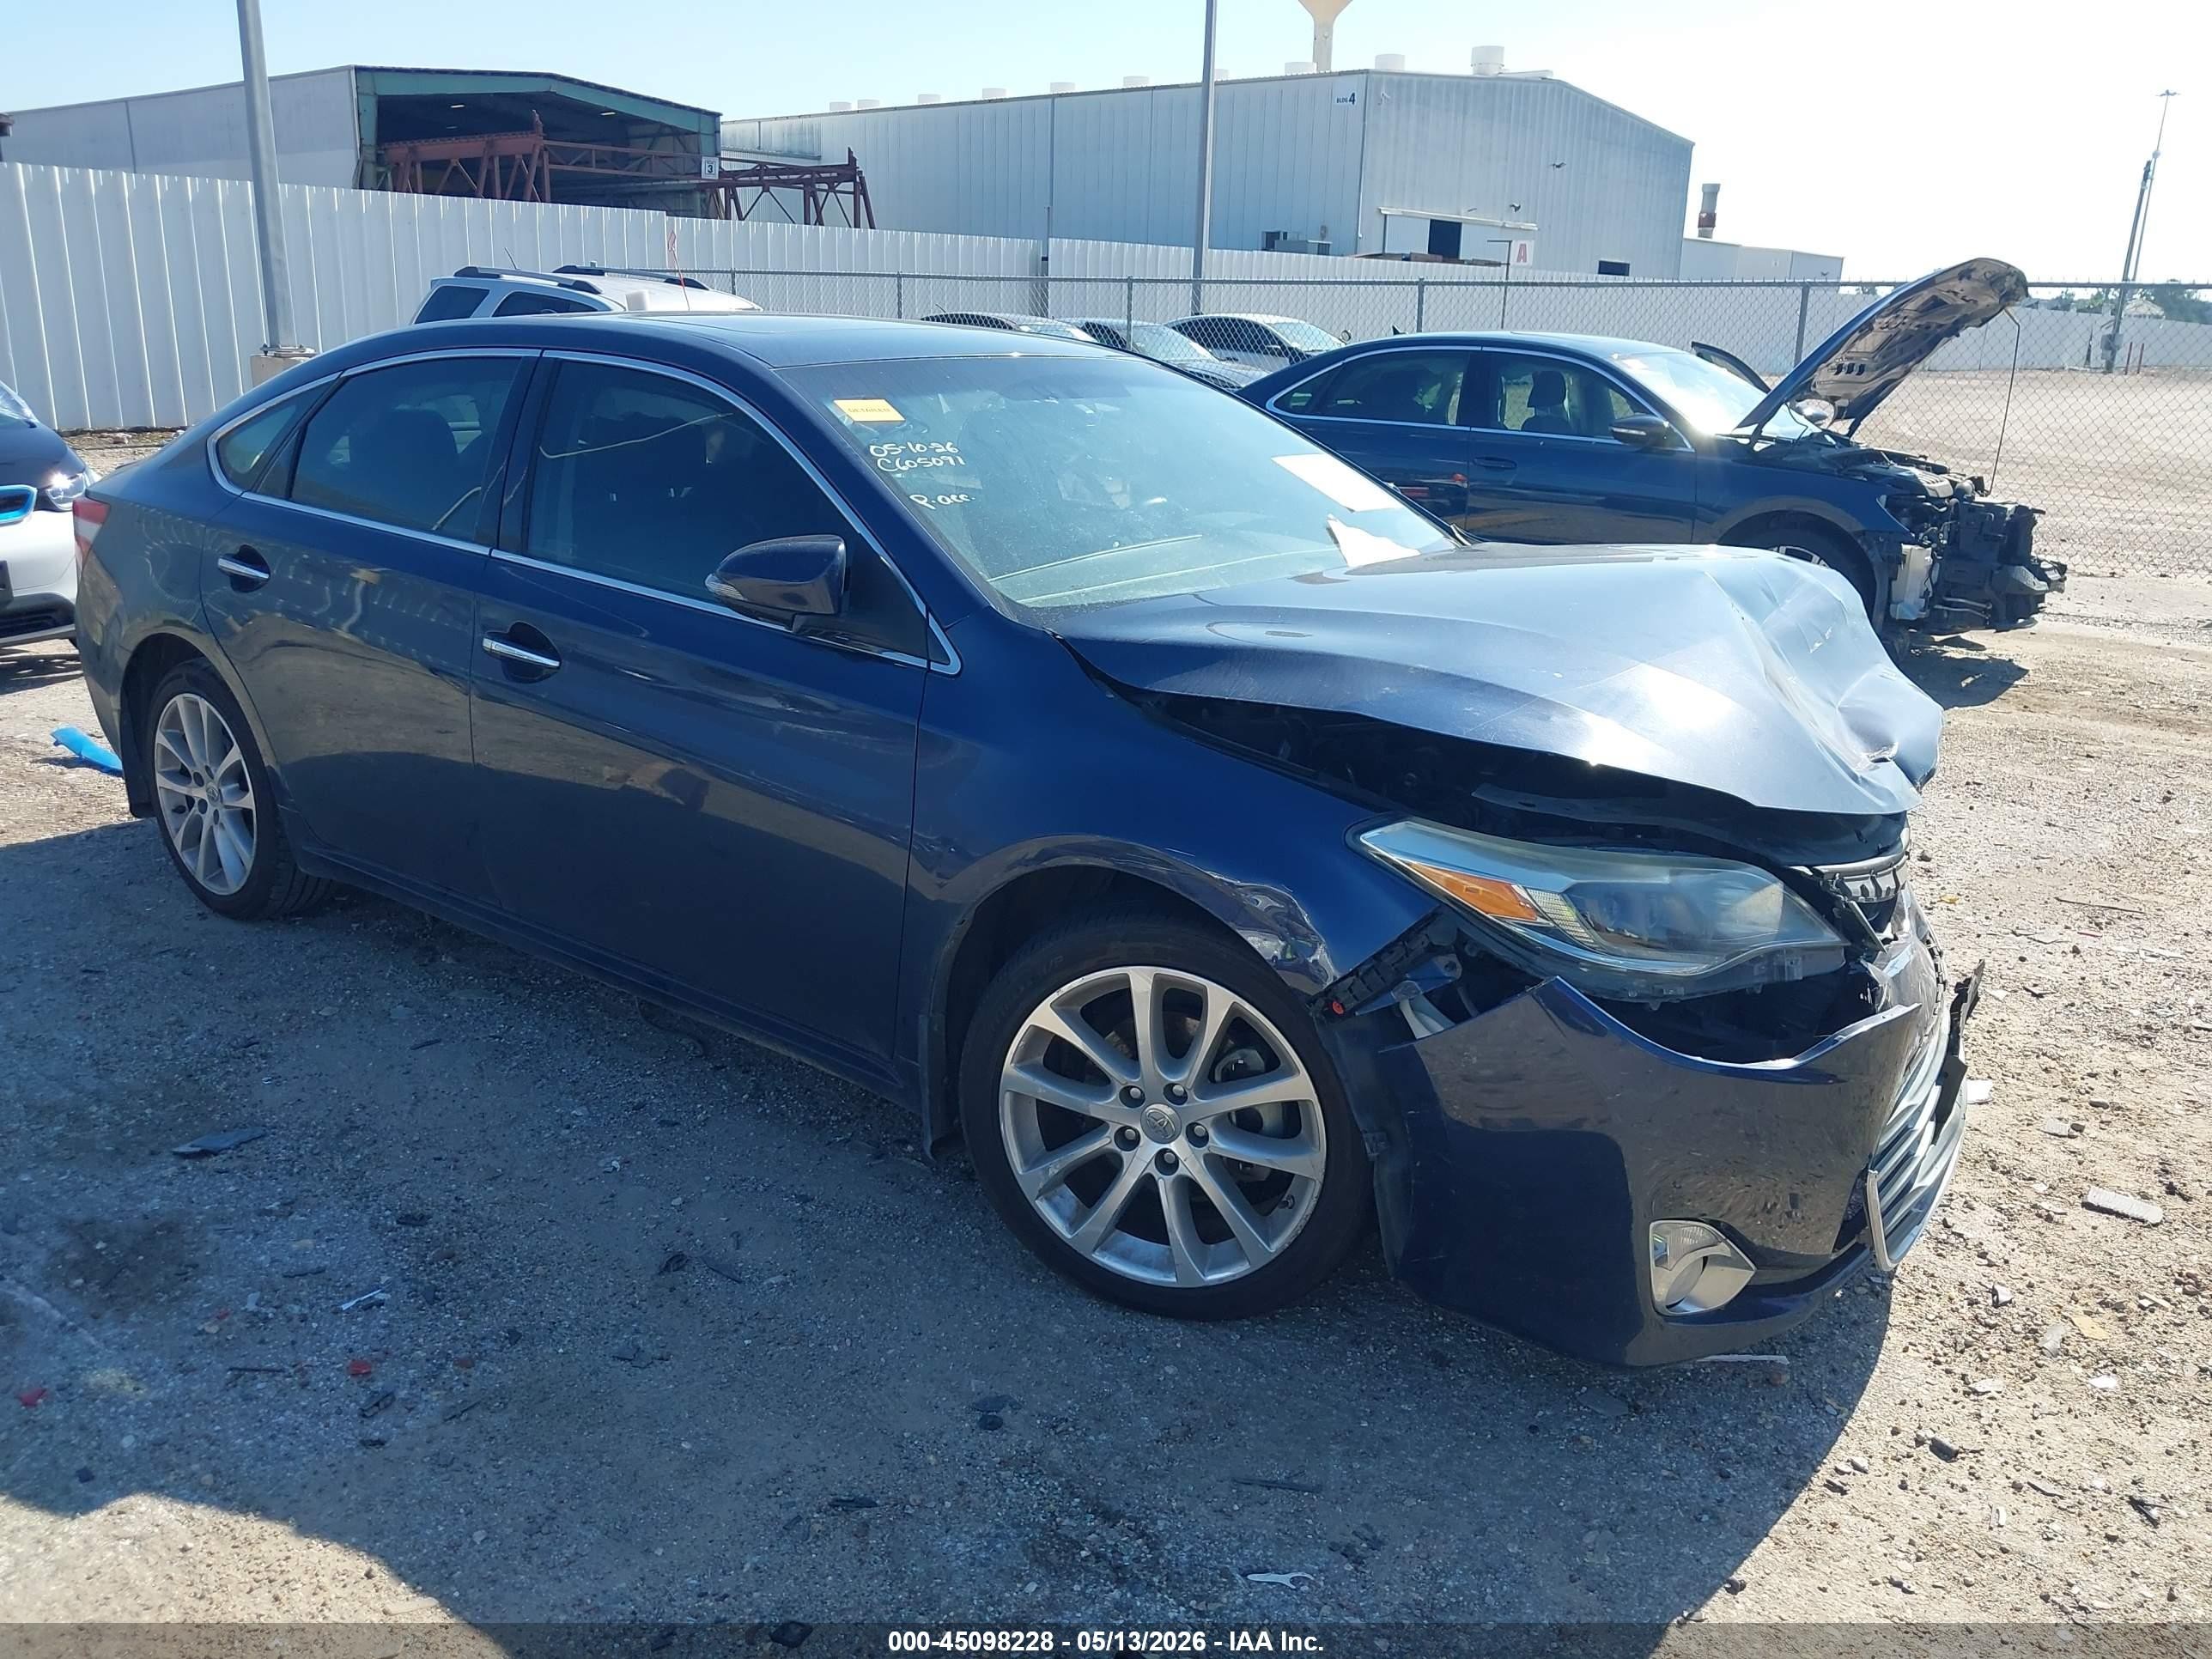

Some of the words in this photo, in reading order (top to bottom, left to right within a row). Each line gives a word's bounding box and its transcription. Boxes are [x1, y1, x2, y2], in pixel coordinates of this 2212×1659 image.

[1348, 92, 1356, 105] 4
[708, 164, 714, 173] 3
[1516, 243, 1528, 263] A
[869, 441, 959, 457] 05-10-26
[877, 455, 966, 472] C605091
